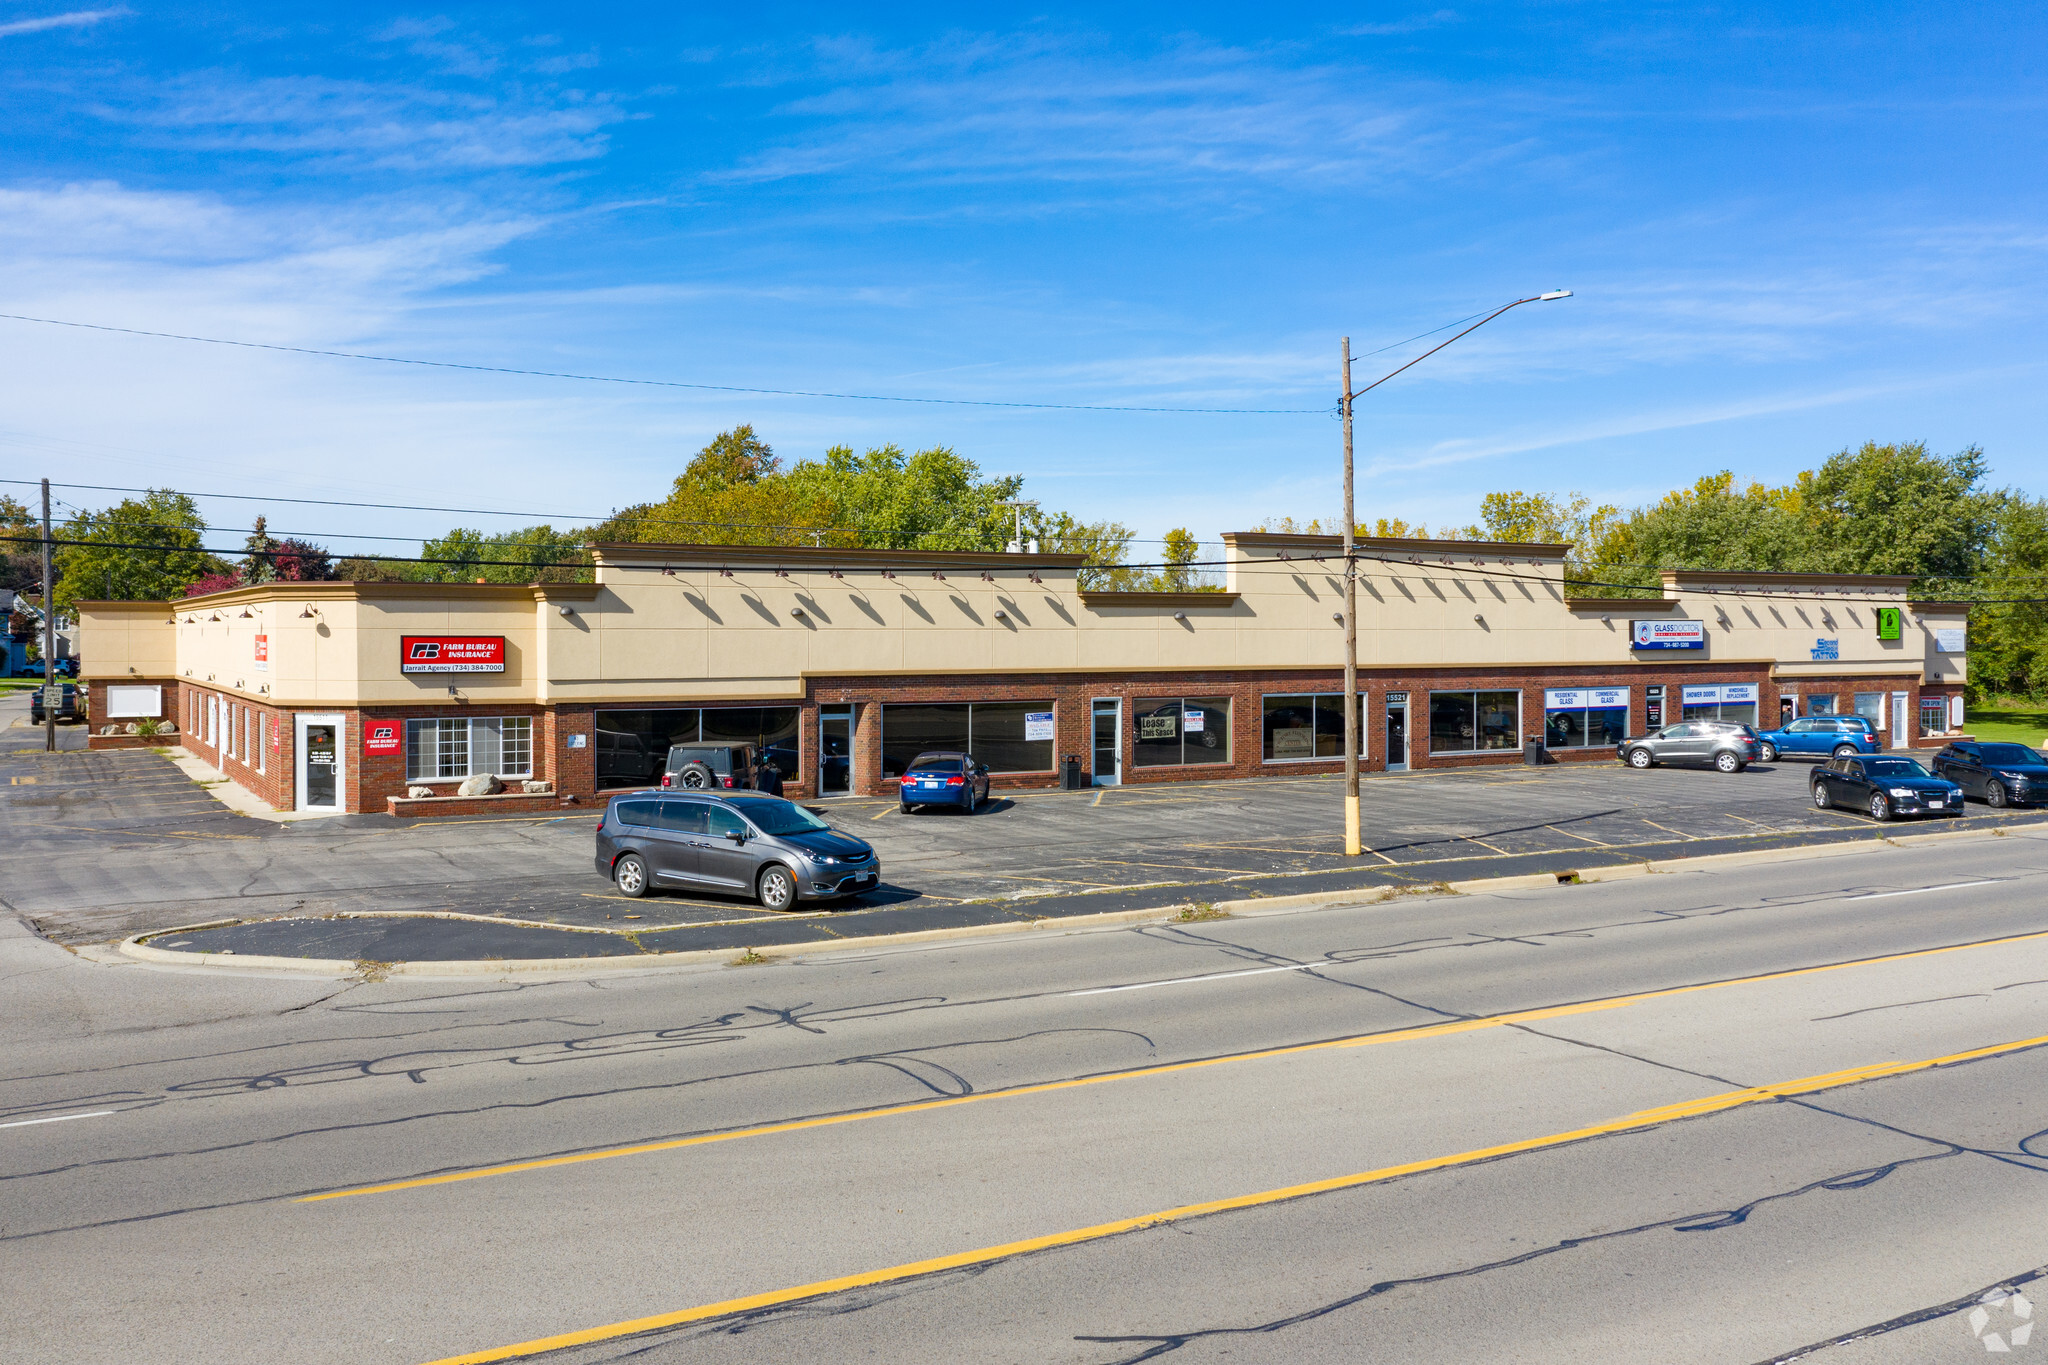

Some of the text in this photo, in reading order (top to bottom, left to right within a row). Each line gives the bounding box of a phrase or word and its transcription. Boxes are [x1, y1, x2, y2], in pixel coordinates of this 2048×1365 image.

[1810, 648, 1839, 660] TATTOO
[1142, 718, 1165, 728] Lease
[1142, 728, 1173, 737] This Space
